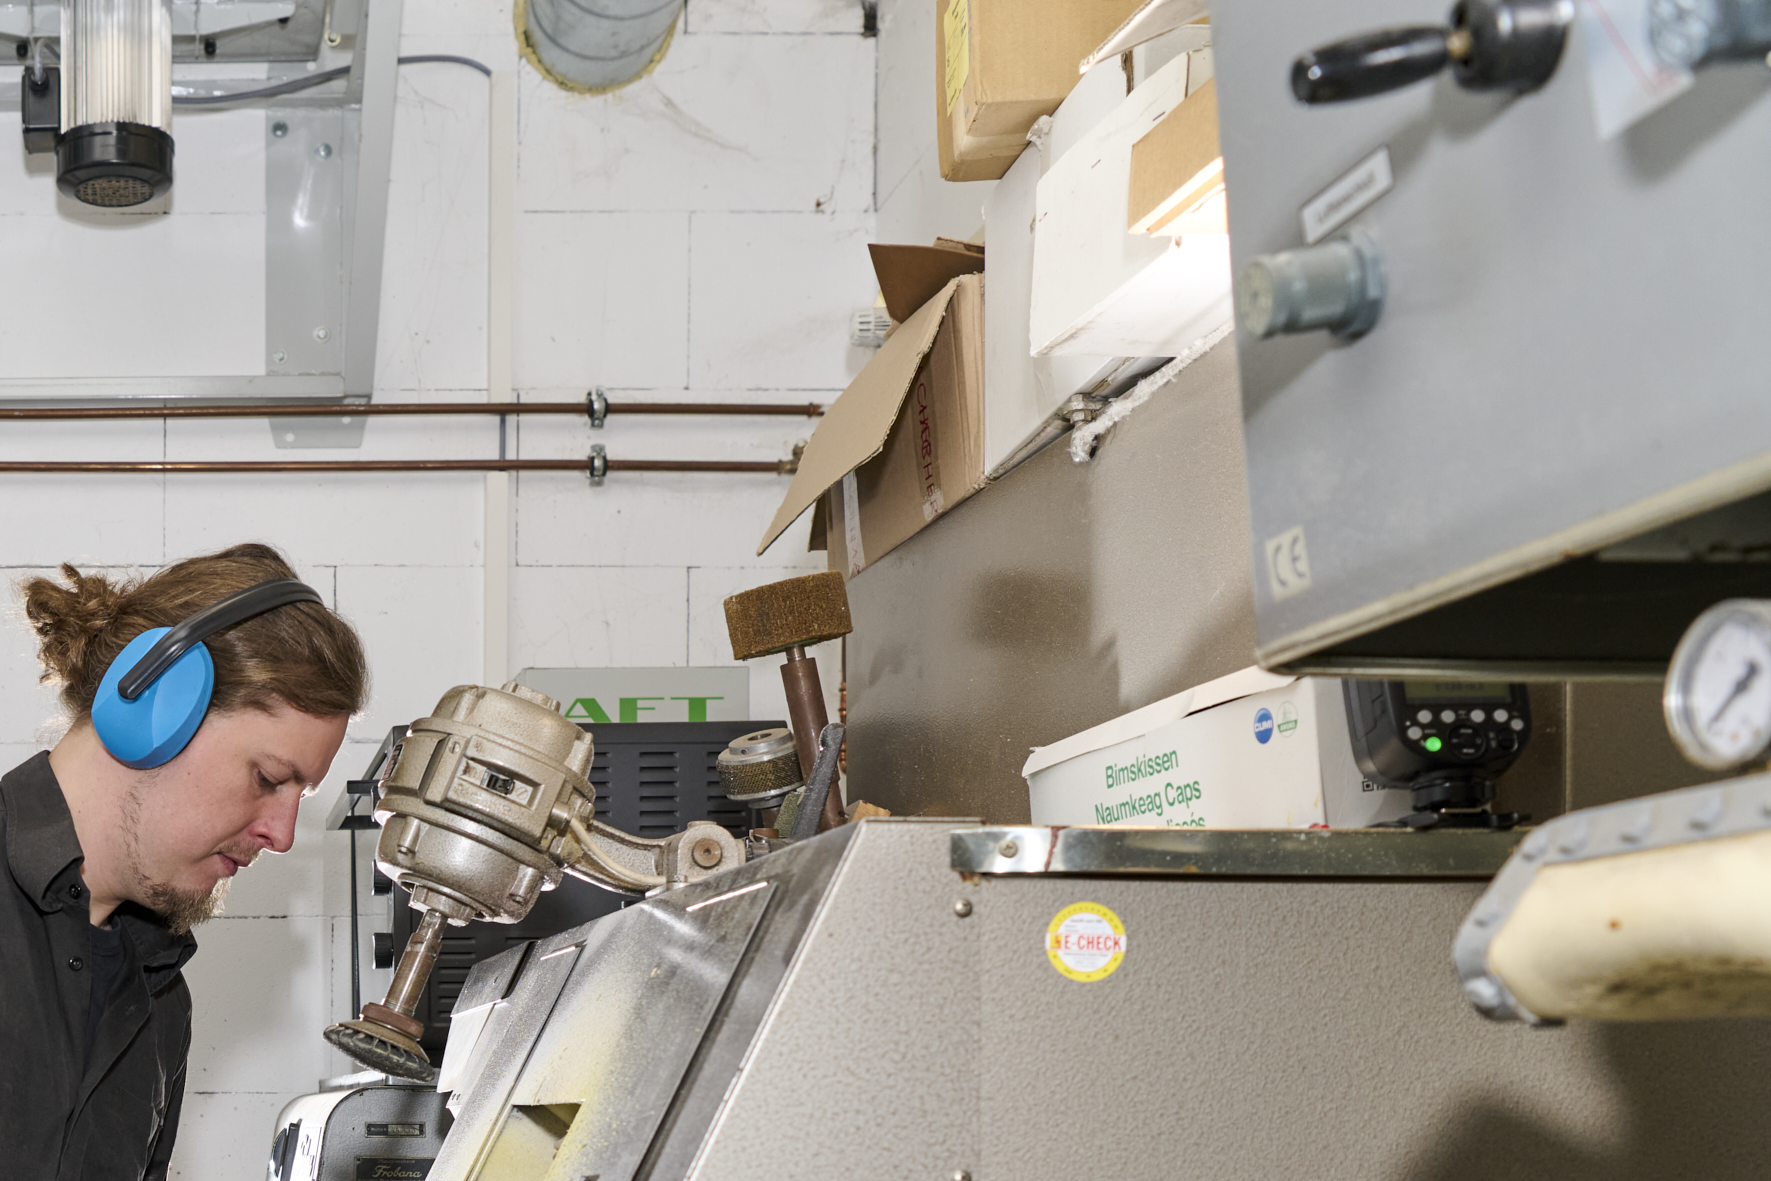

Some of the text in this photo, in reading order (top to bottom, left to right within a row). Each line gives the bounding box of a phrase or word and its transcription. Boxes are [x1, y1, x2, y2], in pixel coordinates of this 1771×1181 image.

[1272, 536, 1306, 587] CE
[1254, 719, 1273, 733] CUMI
[1106, 750, 1179, 789] Bimskissen
[1094, 794, 1164, 825] Naumkeag
[1164, 780, 1202, 809] Caps
[1064, 935, 1122, 951] E-CHECK
[372, 1165, 422, 1178] Frobana
